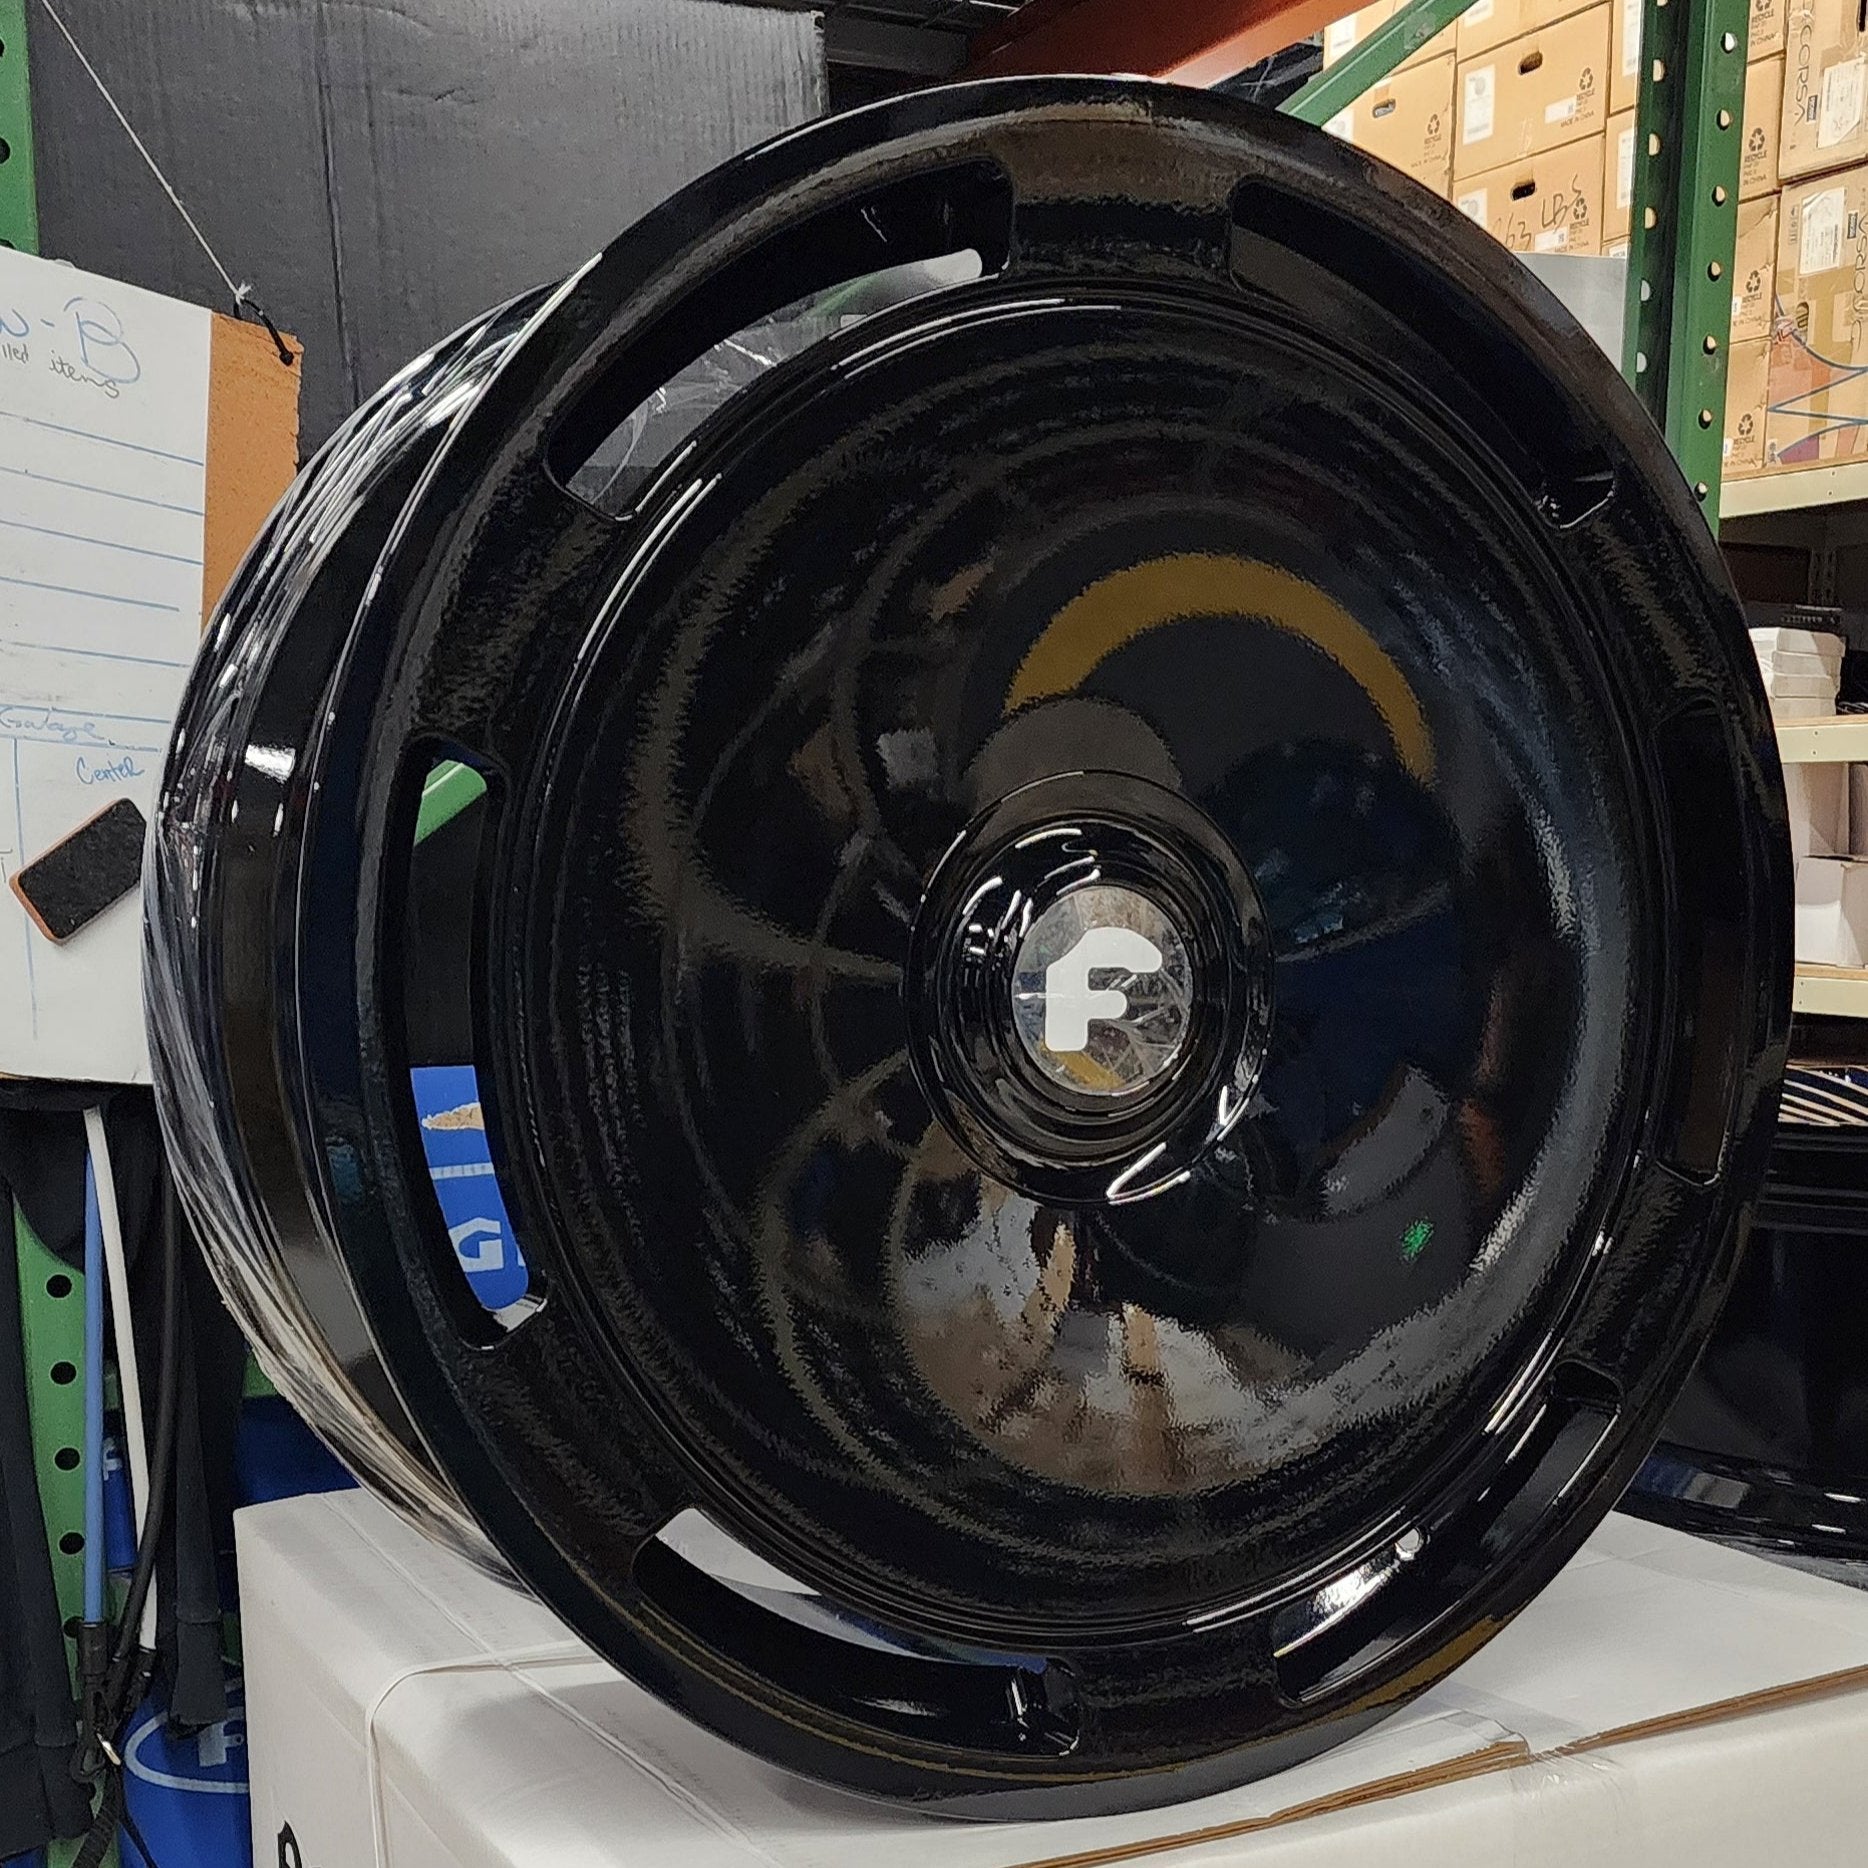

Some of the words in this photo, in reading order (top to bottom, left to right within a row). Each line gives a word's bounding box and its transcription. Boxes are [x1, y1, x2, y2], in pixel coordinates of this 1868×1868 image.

[1795, 24, 1812, 126] CORSA
[49, 349, 120, 399] items
[1045, 926, 1163, 1052] F
